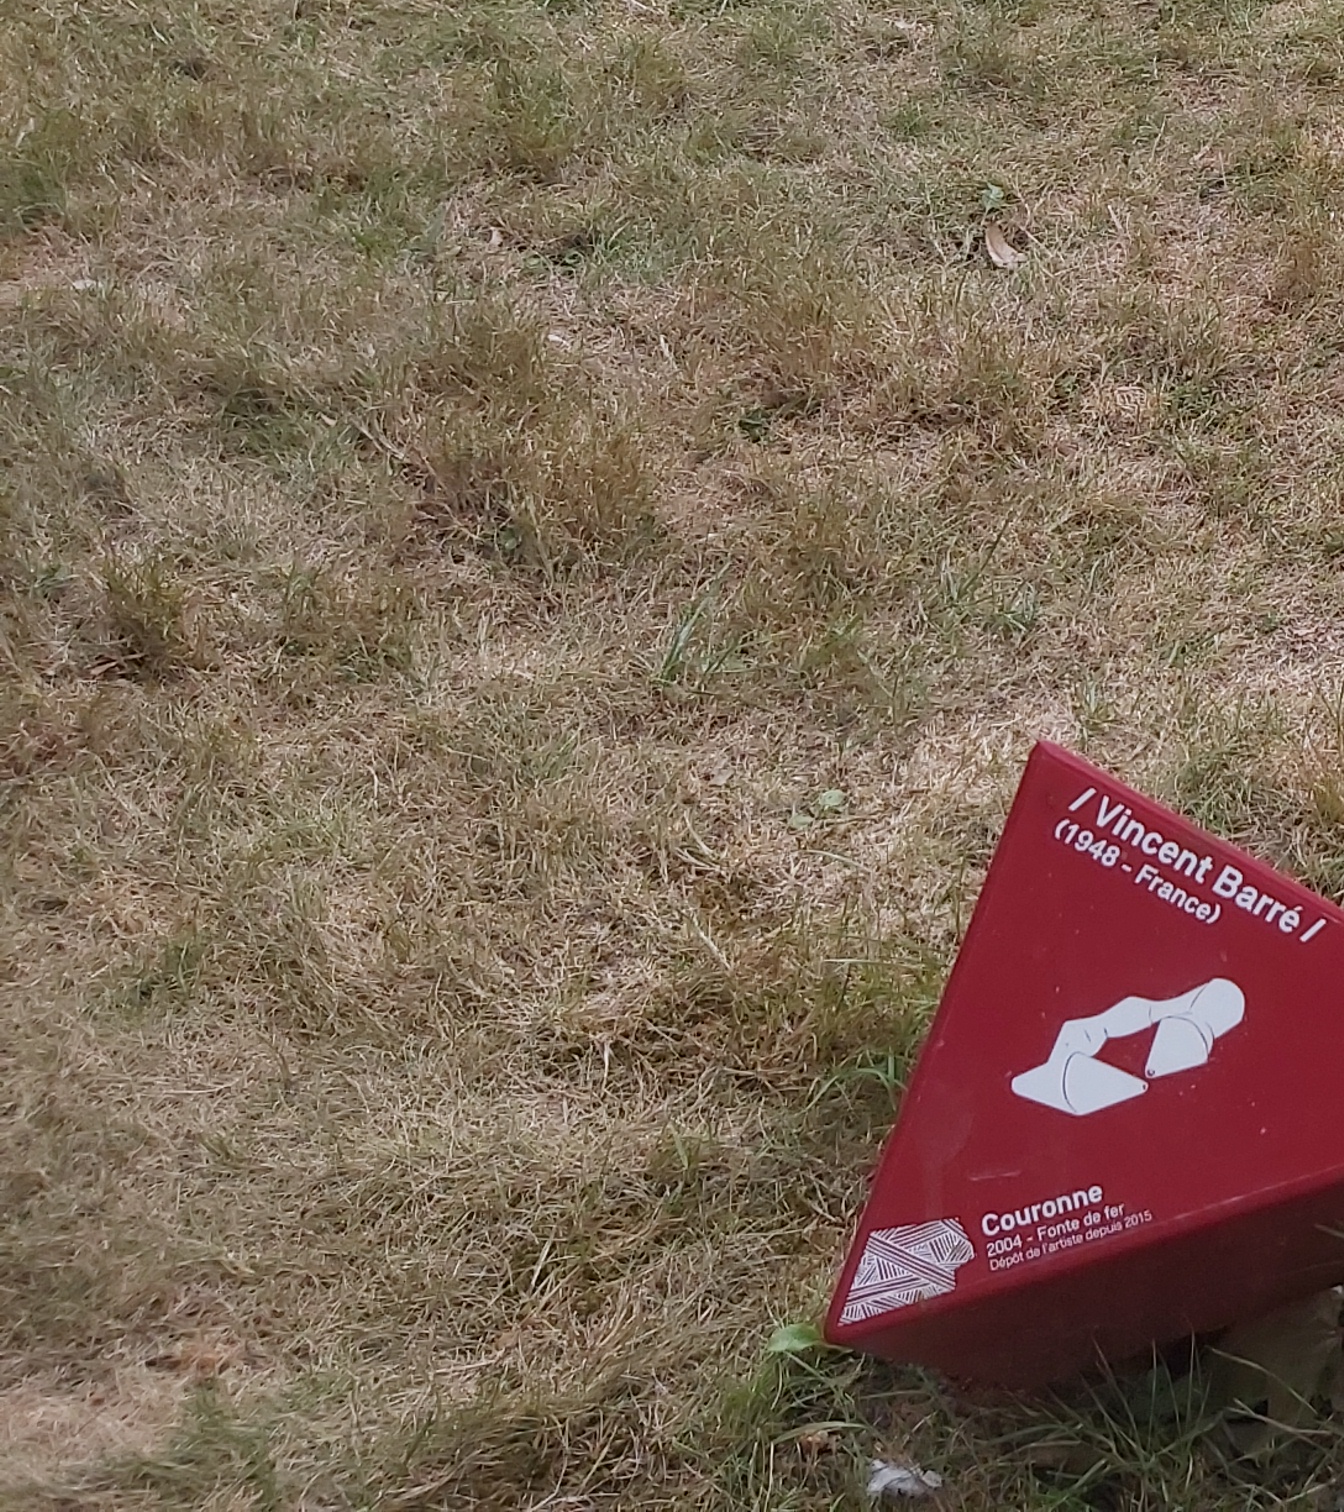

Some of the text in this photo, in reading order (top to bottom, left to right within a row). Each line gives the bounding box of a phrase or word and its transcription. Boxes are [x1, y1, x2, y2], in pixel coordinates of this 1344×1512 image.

[1054, 819, 1120, 867] (1948
[1134, 864, 1221, 924] France)
[1095, 795, 1214, 884] Vincent
[1212, 864, 1303, 933] Barré
[981, 1185, 1103, 1236] Couronne
[986, 1235, 1022, 1257] 2004
[1037, 1220, 1079, 1241] Fonte
[1083, 1211, 1101, 1226] de
[1104, 1204, 1125, 1220] fer
[989, 1251, 1024, 1271] Dépôt
[1025, 1246, 1041, 1260] de
[1085, 1221, 1123, 1240] depuis
[1124, 1210, 1152, 1229] 2015
